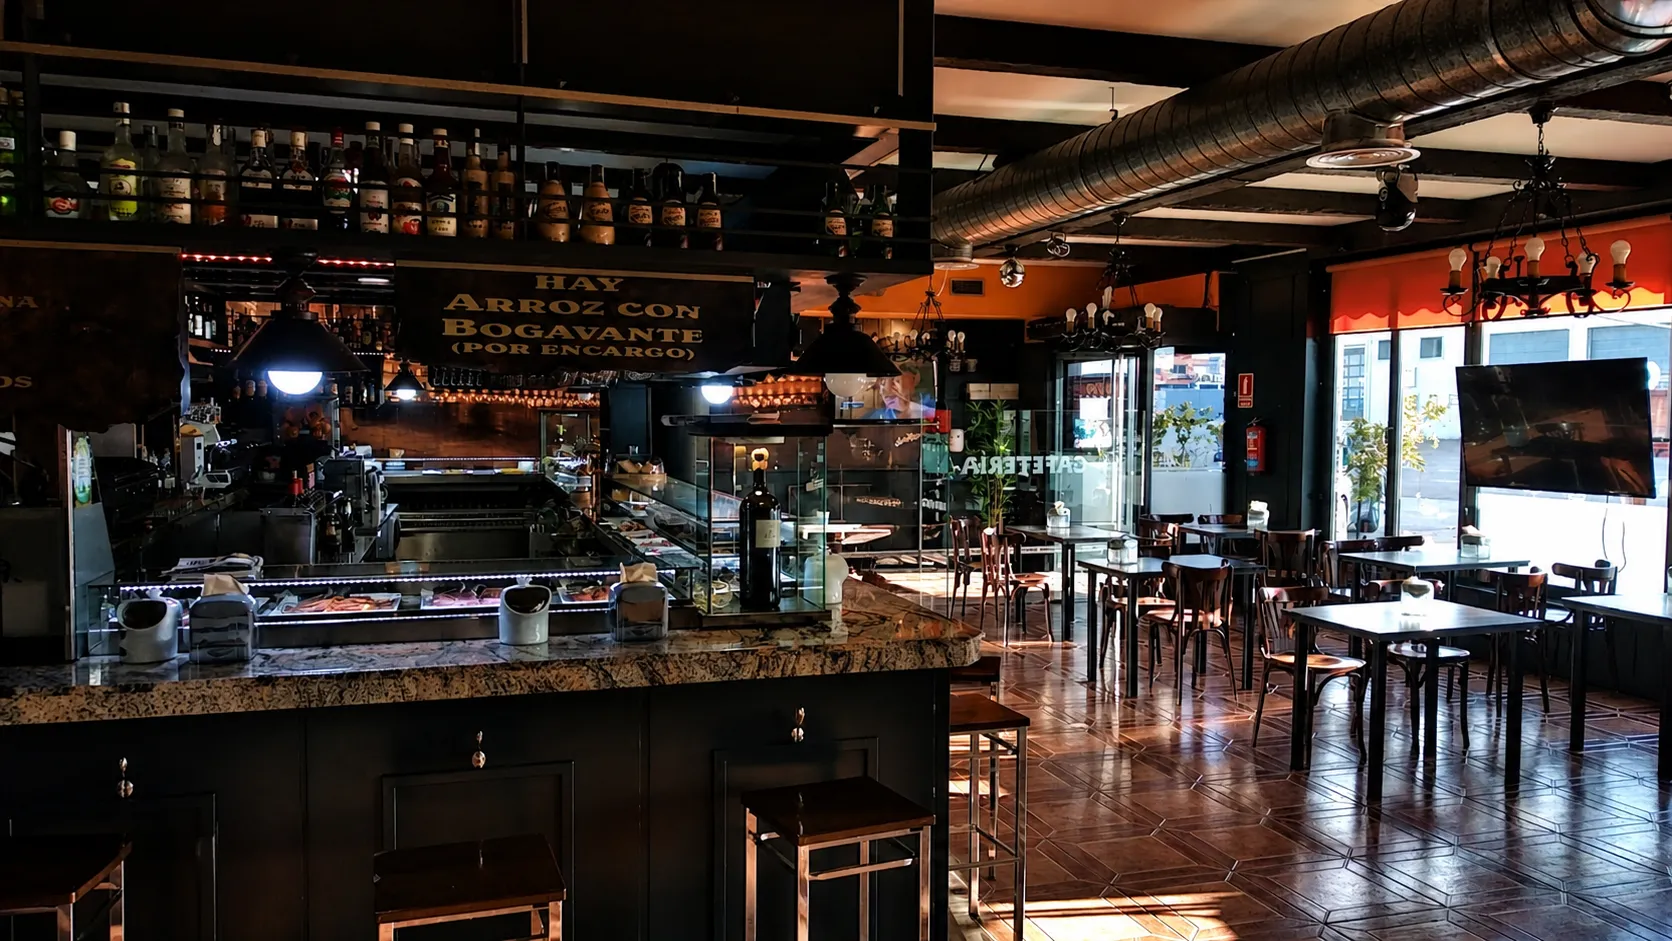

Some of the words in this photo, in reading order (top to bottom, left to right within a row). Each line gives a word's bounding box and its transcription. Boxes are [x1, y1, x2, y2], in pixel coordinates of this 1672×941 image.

[535, 275, 624, 292] HAY
[443, 293, 605, 316] ARROZ
[617, 302, 701, 319] CON
[442, 318, 704, 343] BOGAVANTE
[451, 341, 531, 355] (POR
[540, 344, 696, 361] ENCARGO)
